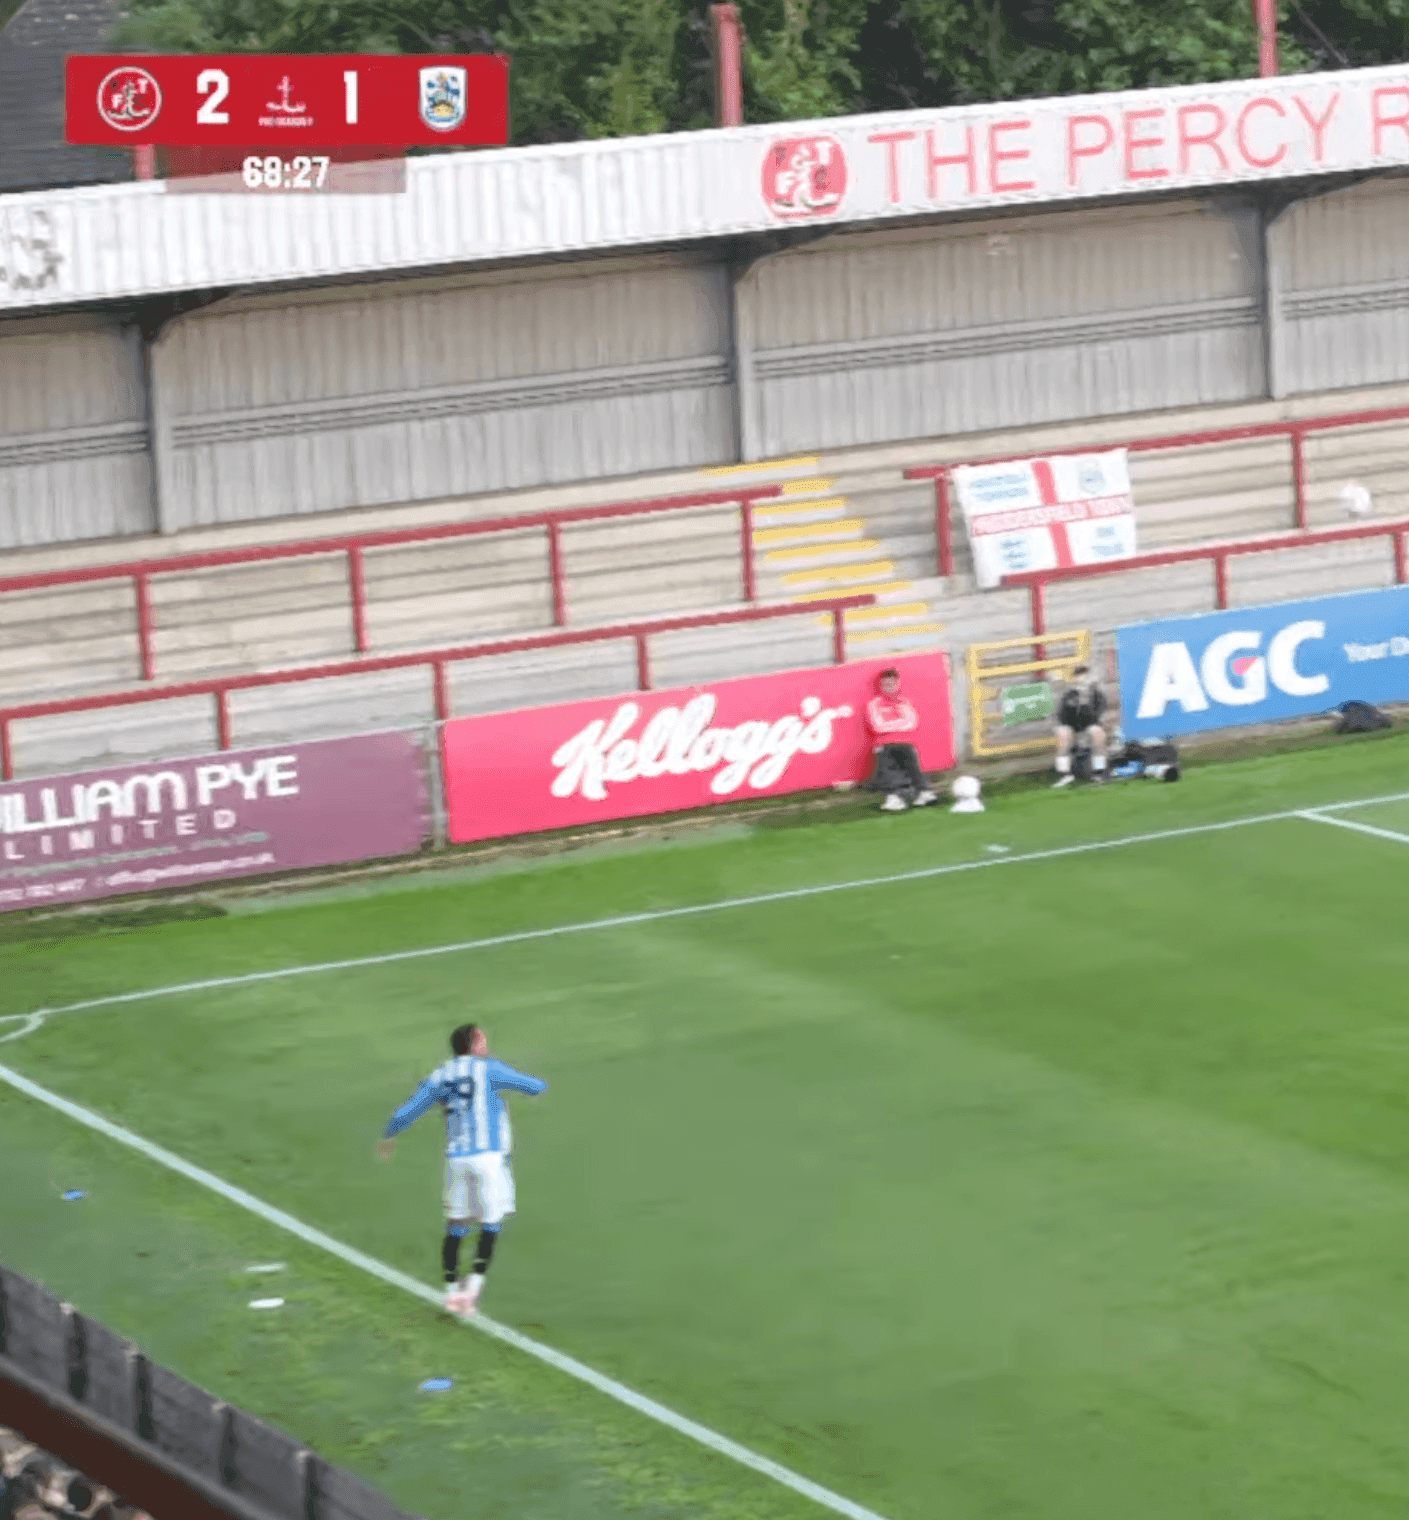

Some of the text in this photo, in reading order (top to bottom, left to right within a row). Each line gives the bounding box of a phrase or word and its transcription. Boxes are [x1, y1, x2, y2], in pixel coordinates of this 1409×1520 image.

[866, 119, 1037, 204] THE
[1062, 92, 1343, 188] PERCY
[1136, 619, 1330, 719] AGC
[1343, 641, 1389, 662] Your
[0, 755, 299, 833] ILLIAM PYE
[550, 692, 854, 801] Kellogg's
[3, 809, 237, 860] LIMITED
